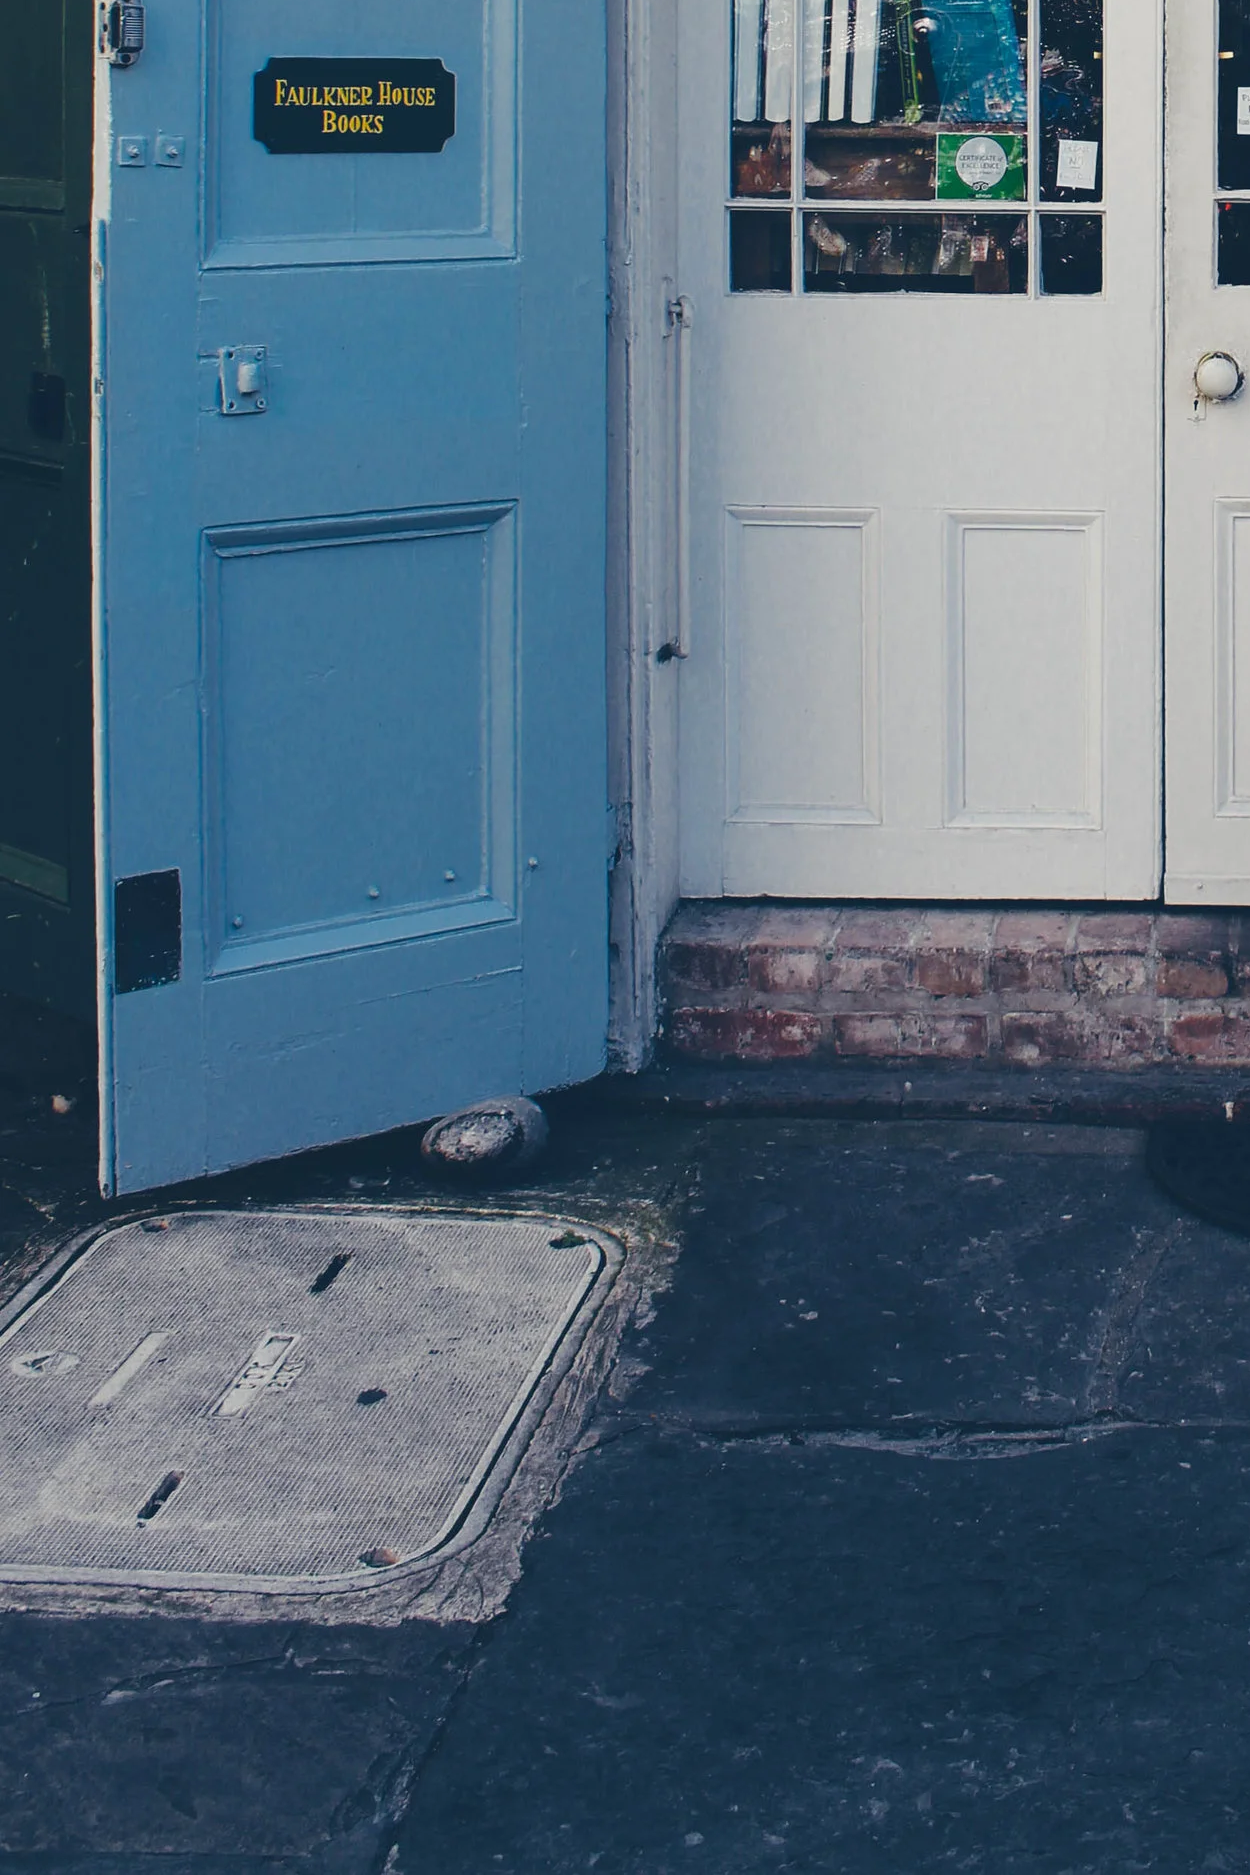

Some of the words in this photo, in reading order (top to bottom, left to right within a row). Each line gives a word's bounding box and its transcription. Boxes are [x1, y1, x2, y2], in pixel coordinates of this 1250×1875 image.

[274, 78, 373, 106] FAULKNER
[376, 81, 436, 107] HOUSE
[321, 109, 385, 134] BOOKS
